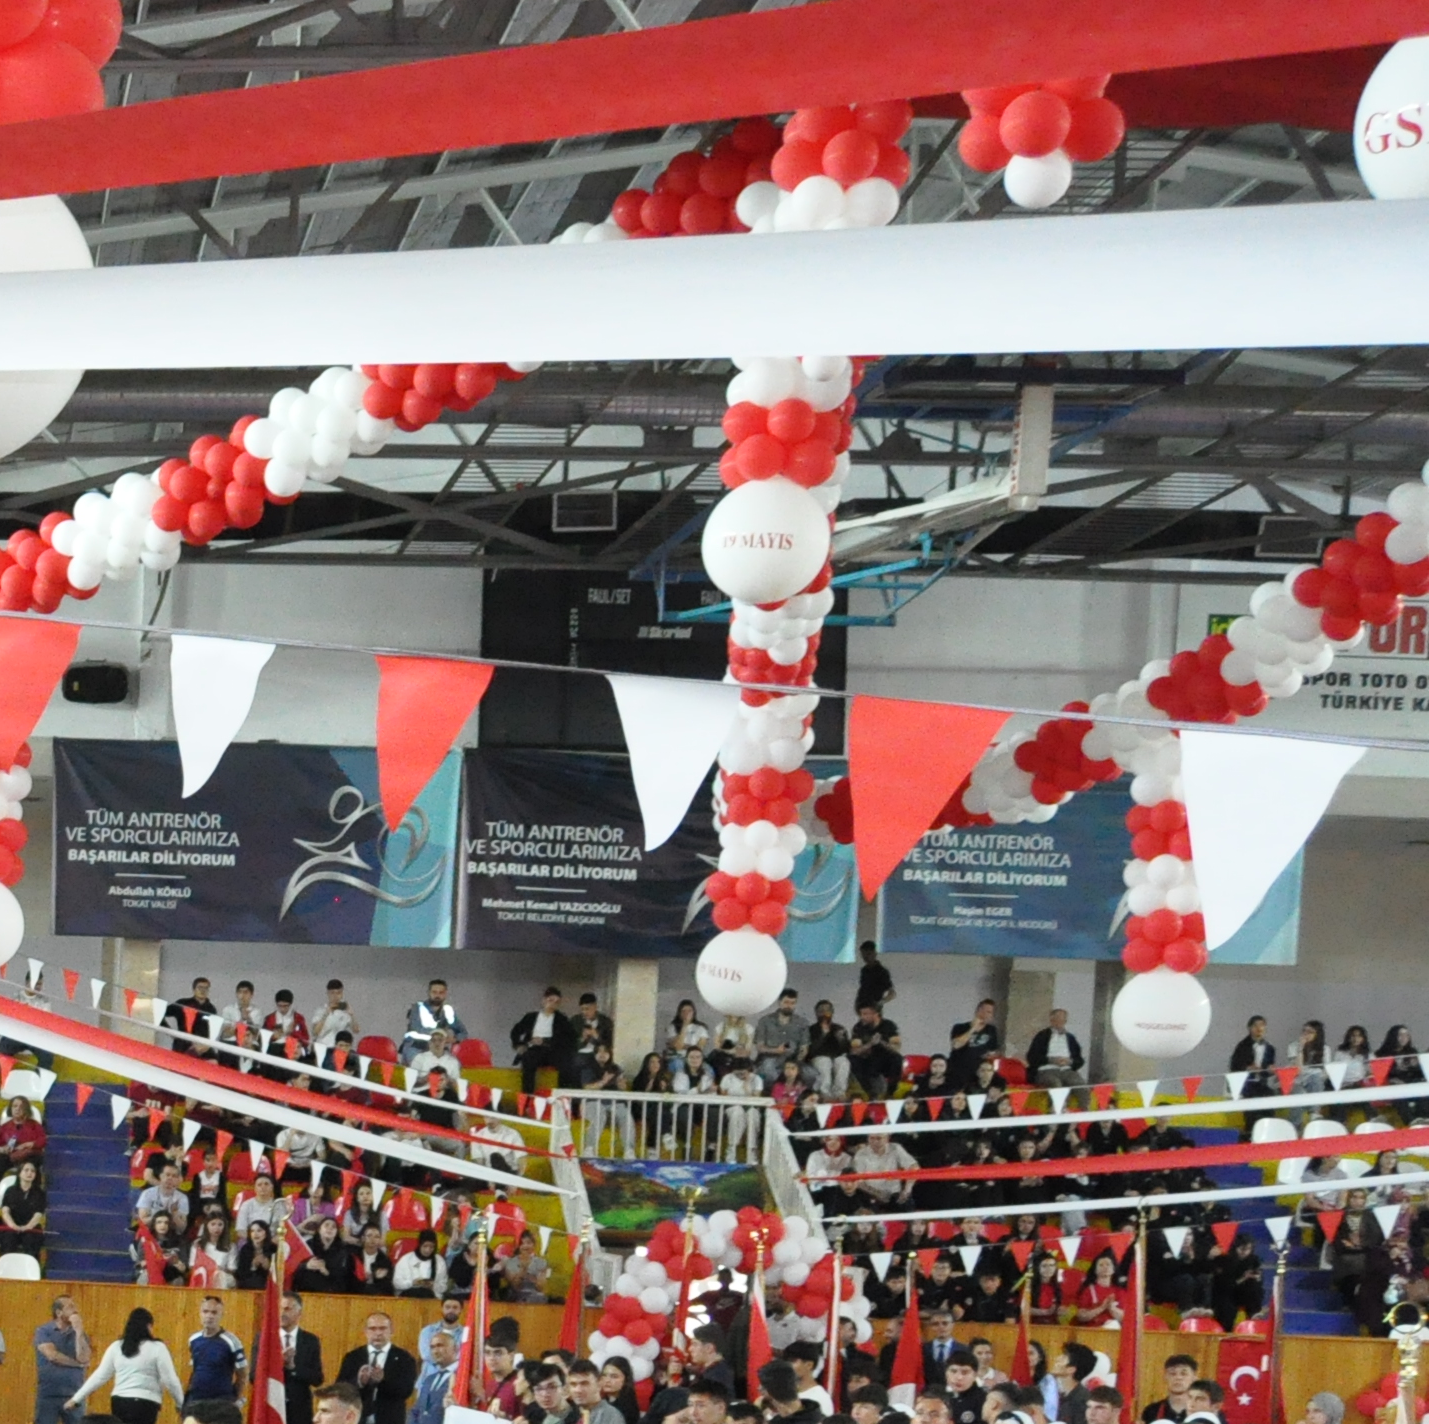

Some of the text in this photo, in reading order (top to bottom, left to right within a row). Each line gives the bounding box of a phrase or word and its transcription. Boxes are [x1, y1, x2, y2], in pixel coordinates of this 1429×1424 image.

[1364, 106, 1429, 155] GS
[740, 532, 794, 550] MAYIS
[1360, 673, 1408, 689] TOTO
[1320, 690, 1405, 712] TÜRKİYE
[85, 808, 222, 830] TÜM ANTRENÖR
[65, 826, 241, 847] VE SPORCULARIMIZA
[485, 820, 624, 843] TÜM ANTRENÖR
[465, 839, 642, 861] VE SPORCULARIMIZA
[962, 833, 1055, 850] ANTRENÖR
[67, 848, 236, 867] BAŞARILAR DİLİYORUM
[925, 849, 1072, 868] SPORCULARIMIZA
[467, 861, 638, 881] BAŞARILAR DİLİYORUM
[903, 869, 1068, 886] BAŞARILAR DİLİYORUM
[108, 886, 191, 898] Abdullah KÖKLÜ
[122, 899, 149, 908] TOKAT
[481, 898, 525, 909] Mehmet
[526, 899, 558, 910] Kemal
[497, 911, 525, 921] TOKAT
